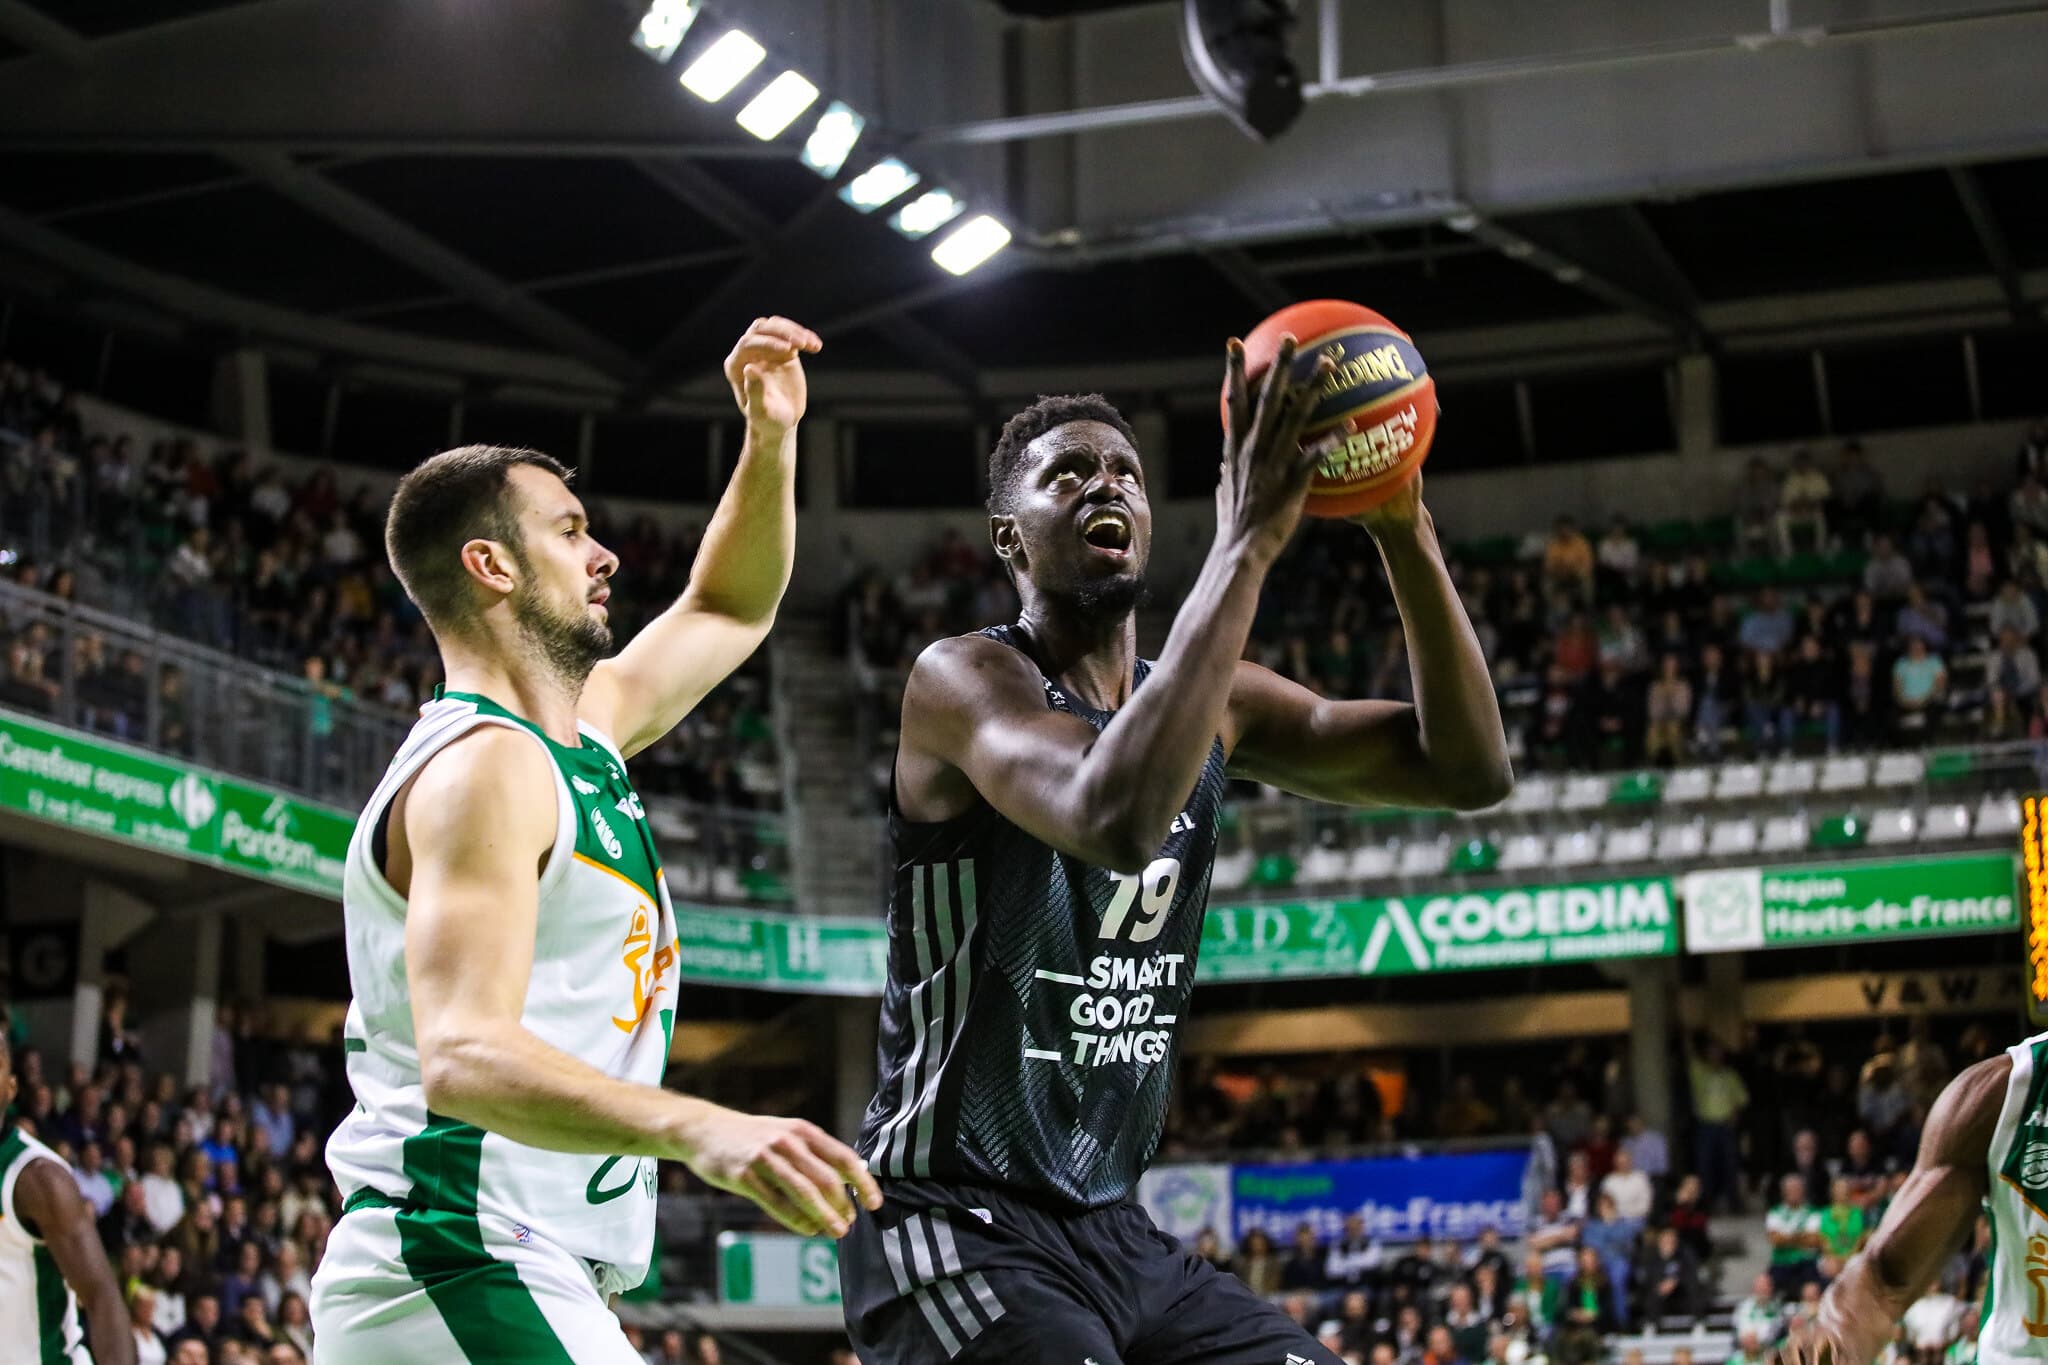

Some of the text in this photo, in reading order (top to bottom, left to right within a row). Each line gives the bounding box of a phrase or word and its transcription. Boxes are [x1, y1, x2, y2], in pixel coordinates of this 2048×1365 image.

[1765, 875, 1847, 905] Région
[1419, 881, 1670, 944] COGEDIM
[1766, 895, 2013, 935] Hauts-de-France
[1086, 953, 1185, 991] SMART
[1070, 993, 1155, 1030] GOOD
